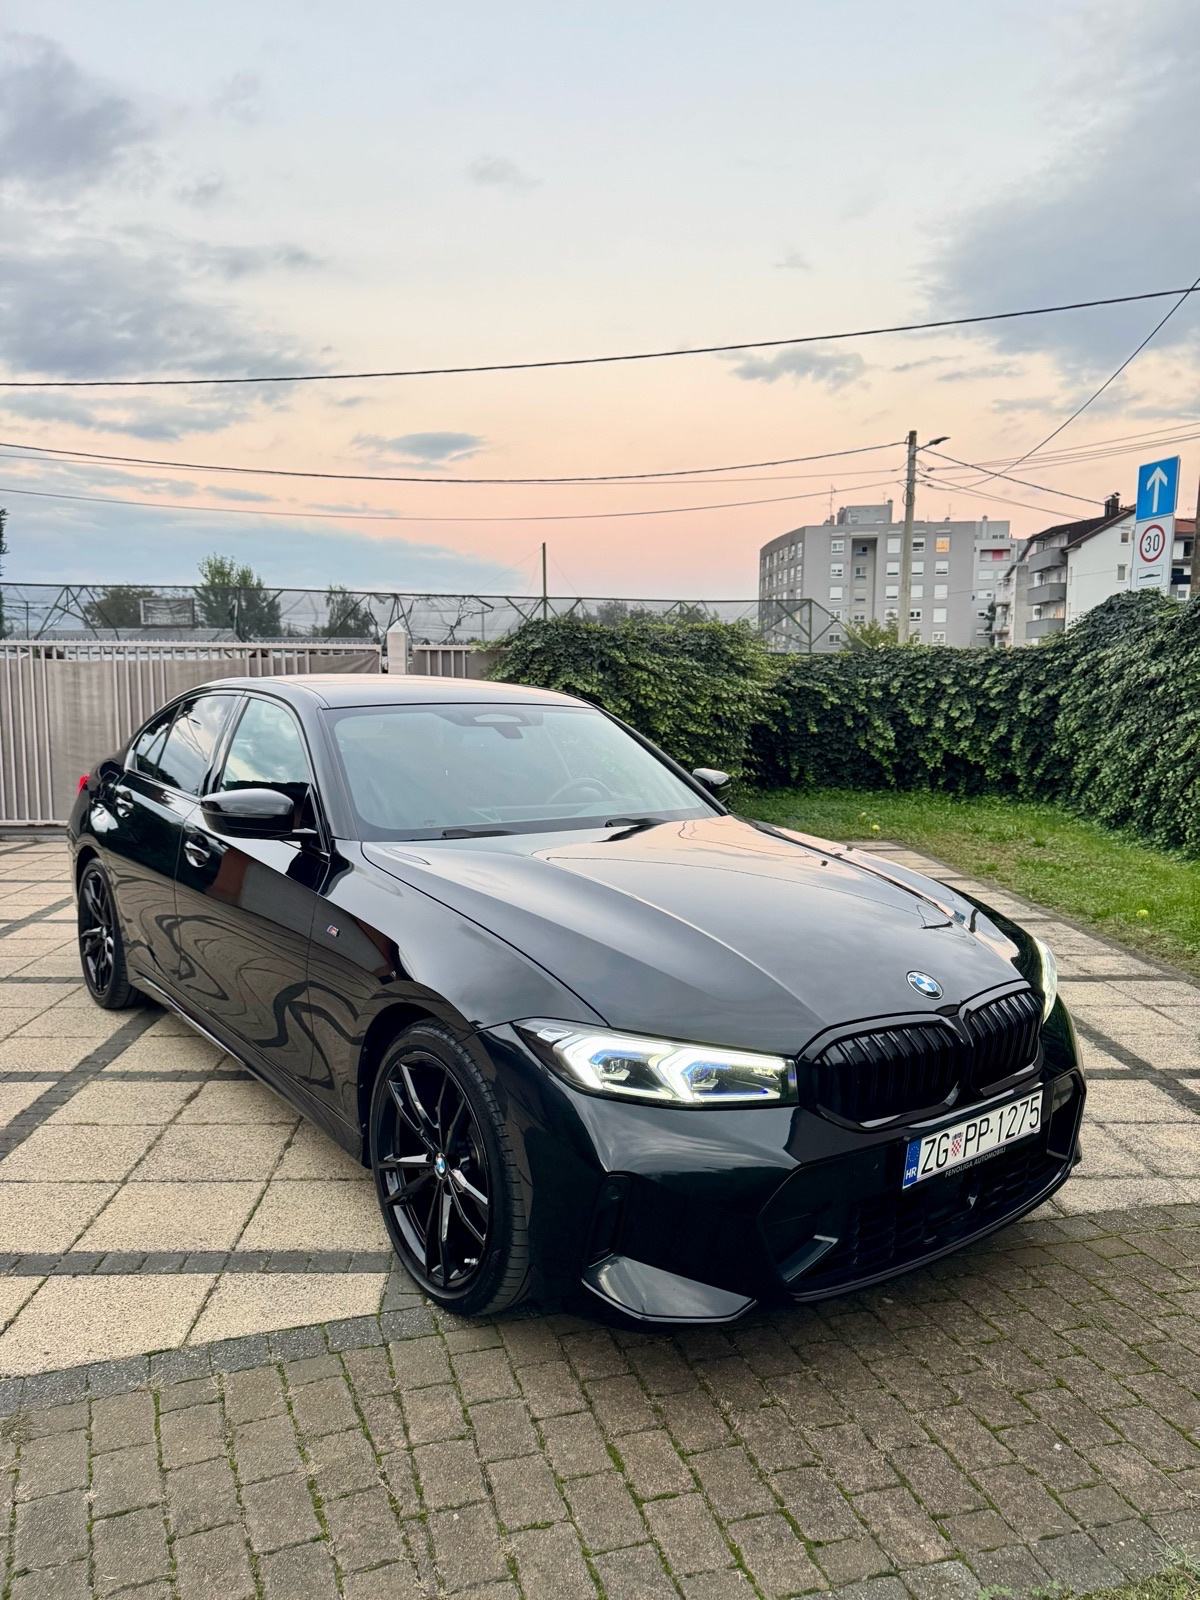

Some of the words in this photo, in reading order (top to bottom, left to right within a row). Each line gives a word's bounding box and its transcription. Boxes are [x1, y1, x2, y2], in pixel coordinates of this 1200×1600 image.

[1144, 534, 1160, 553] 30
[920, 1132, 950, 1175] ZG
[905, 1166, 918, 1180] HR
